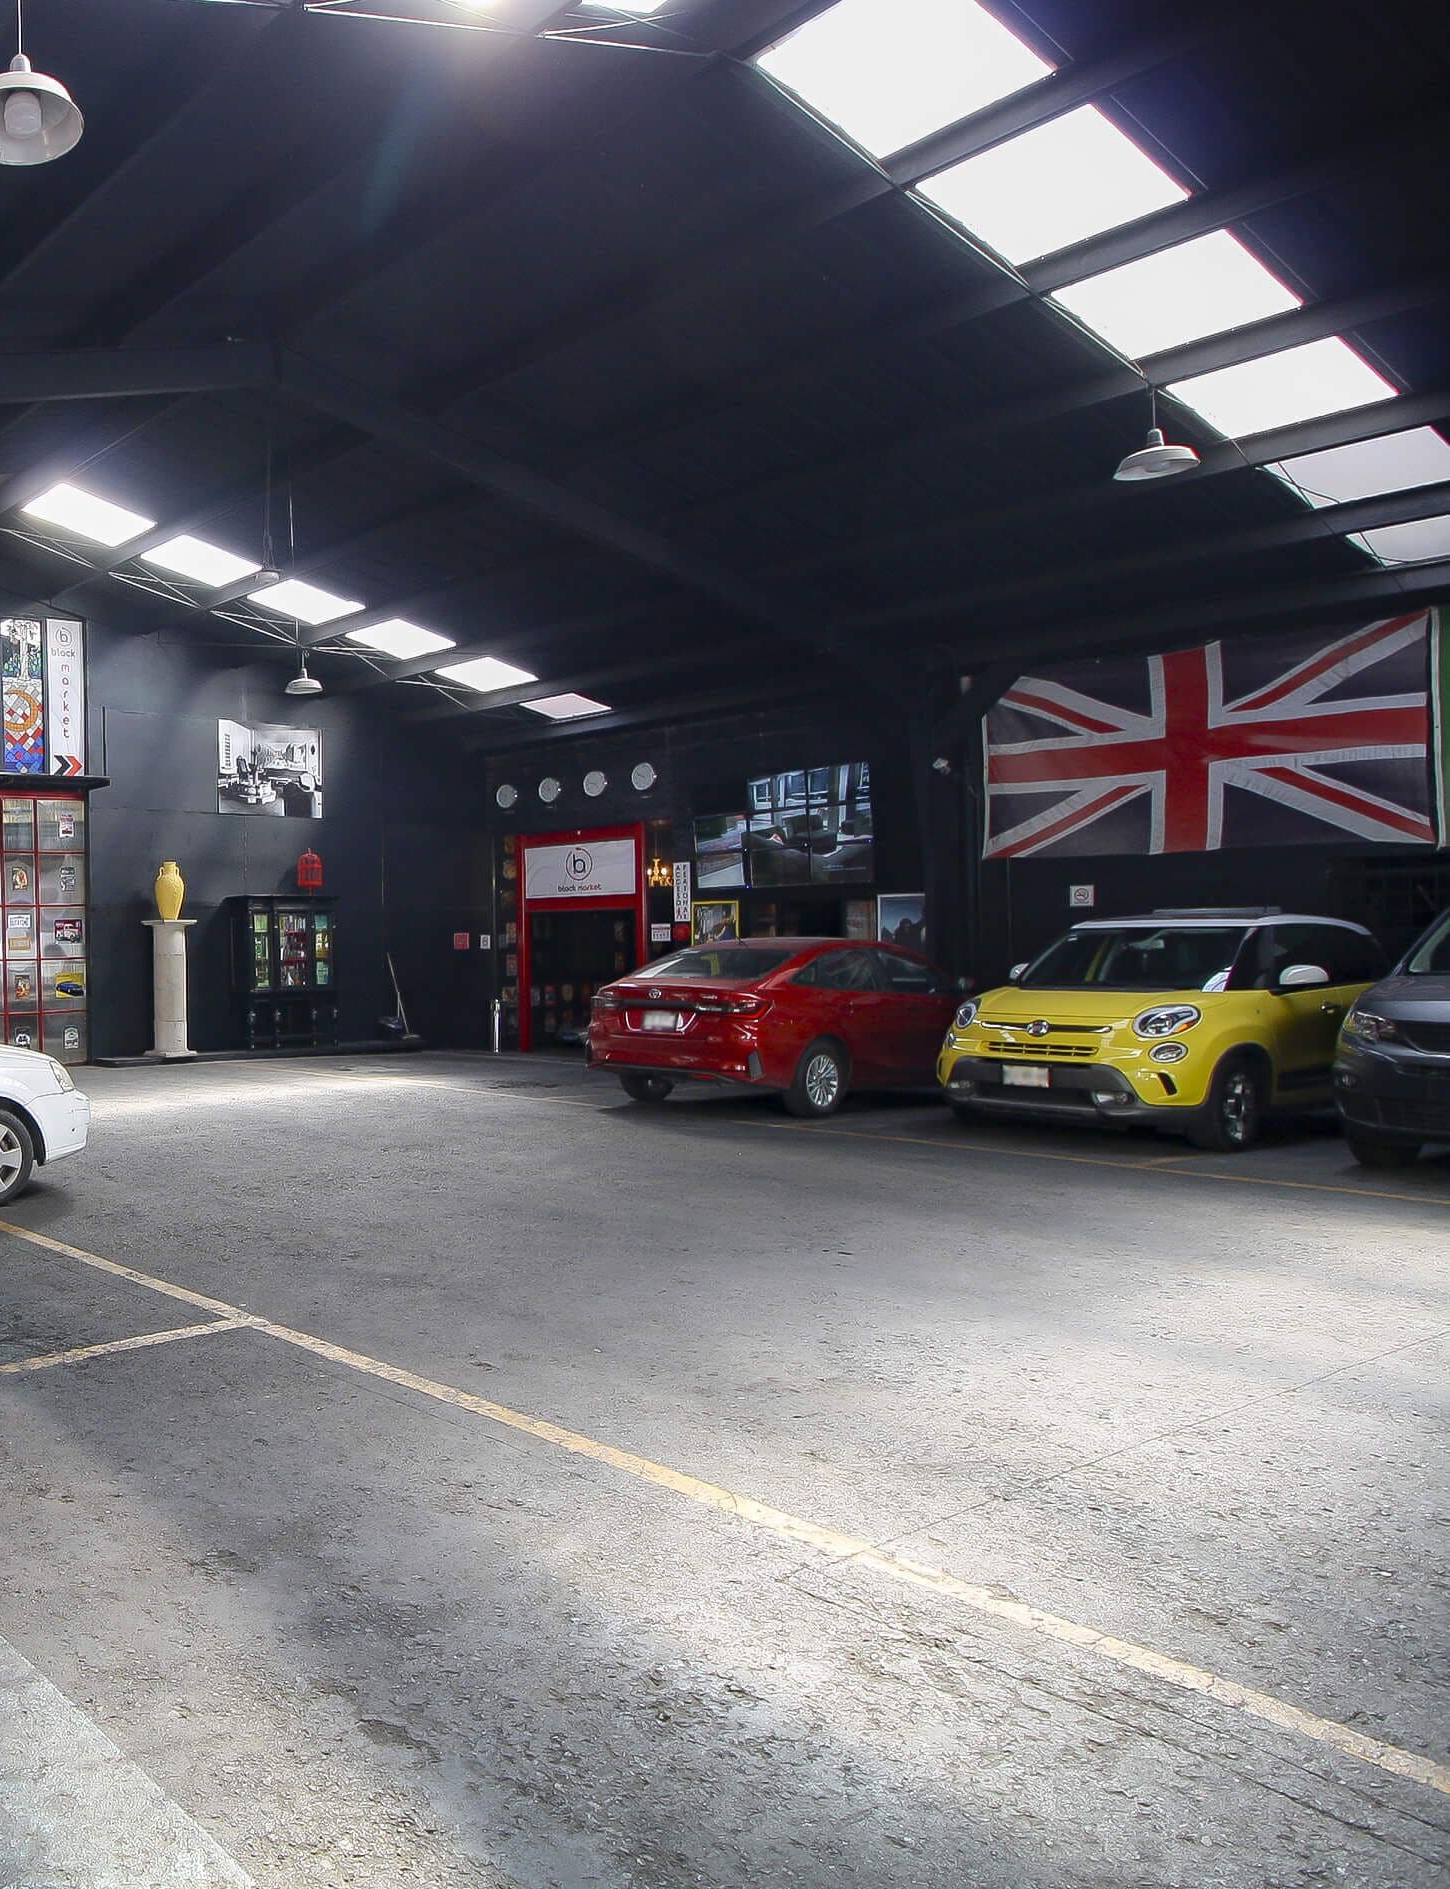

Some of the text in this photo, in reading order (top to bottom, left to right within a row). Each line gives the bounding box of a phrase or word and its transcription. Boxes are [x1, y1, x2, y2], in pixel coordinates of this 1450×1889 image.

[51, 648, 76, 658] black
[61, 663, 70, 738] market
[557, 883, 602, 893] black market
